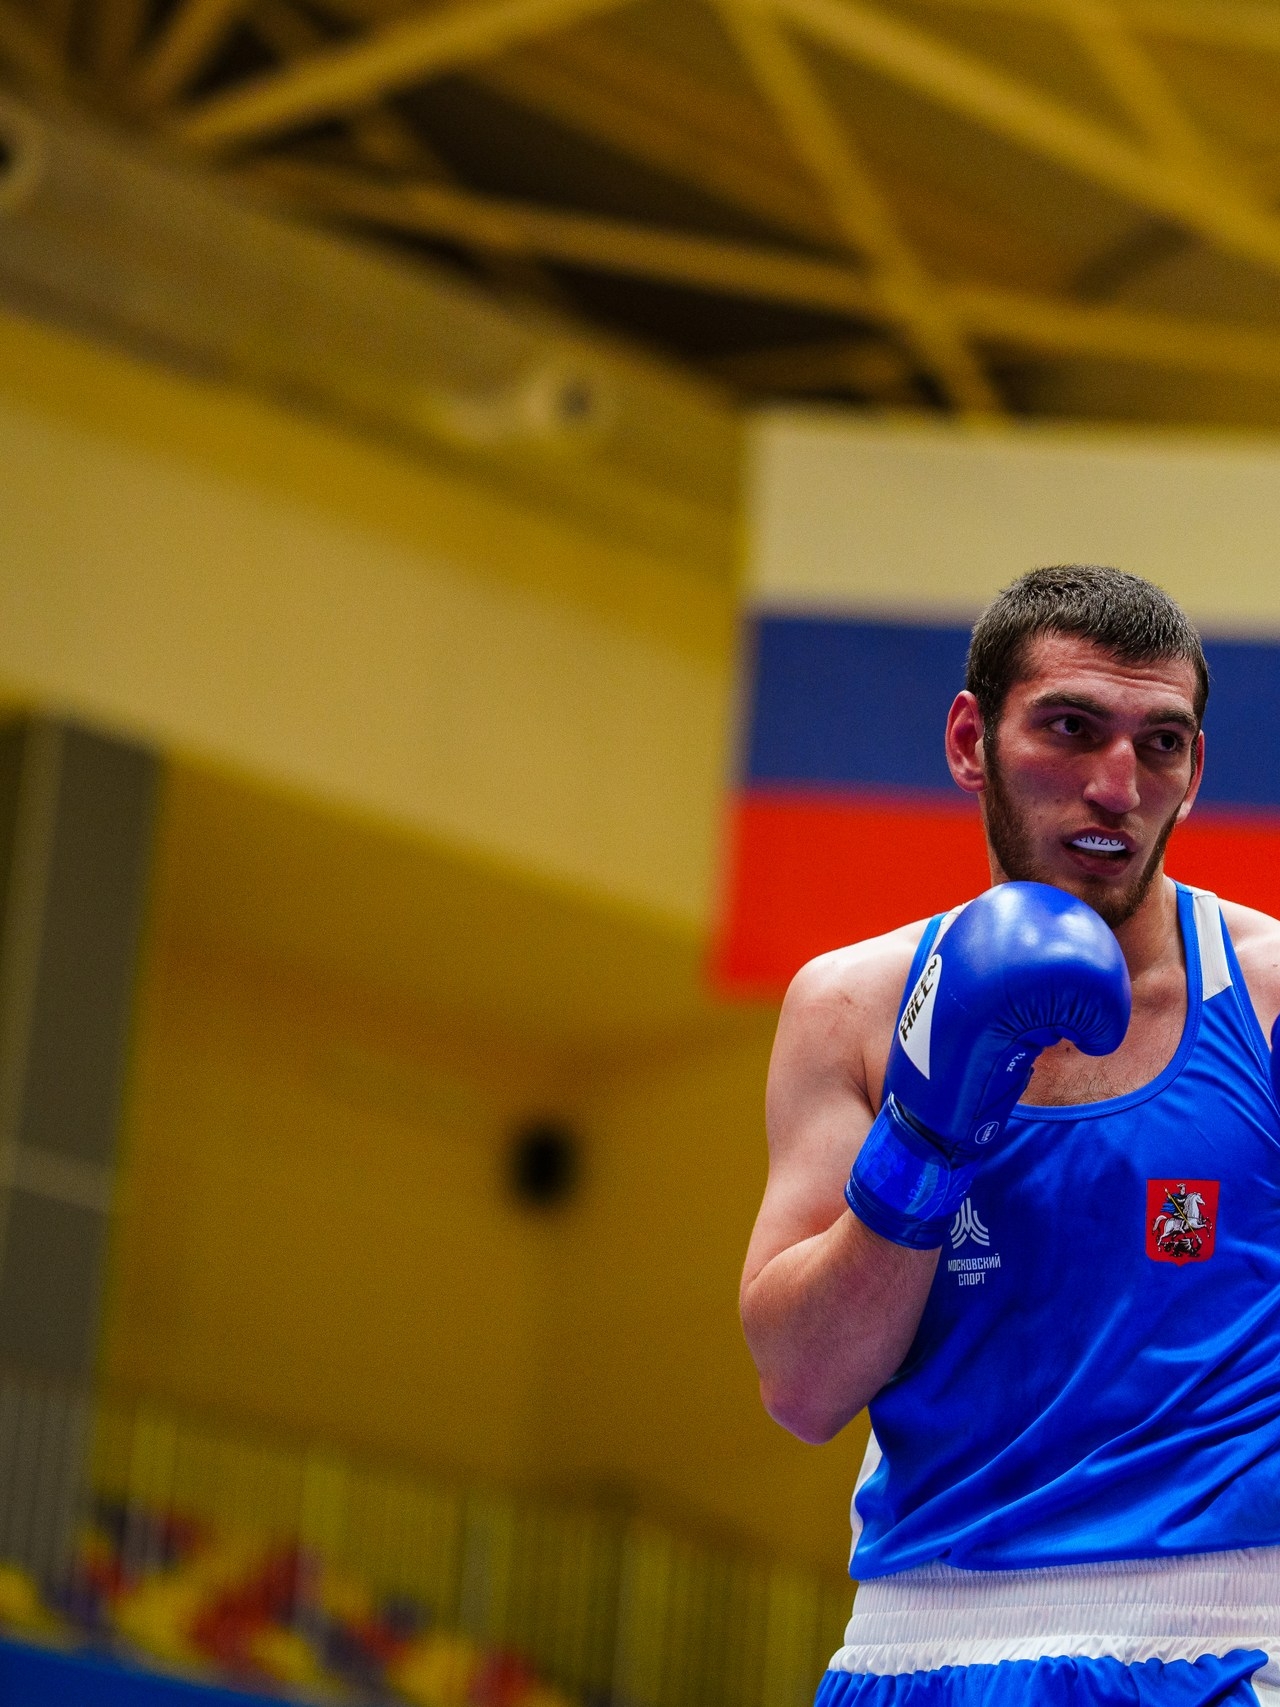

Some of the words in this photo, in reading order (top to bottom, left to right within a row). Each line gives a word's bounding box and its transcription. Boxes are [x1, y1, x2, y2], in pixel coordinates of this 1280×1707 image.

[1079, 836, 1123, 846] NZO
[901, 982, 934, 1042] HILL
[947, 1253, 1001, 1272] МОСКОВСКИЙ
[958, 1271, 987, 1287] СПОРТ
